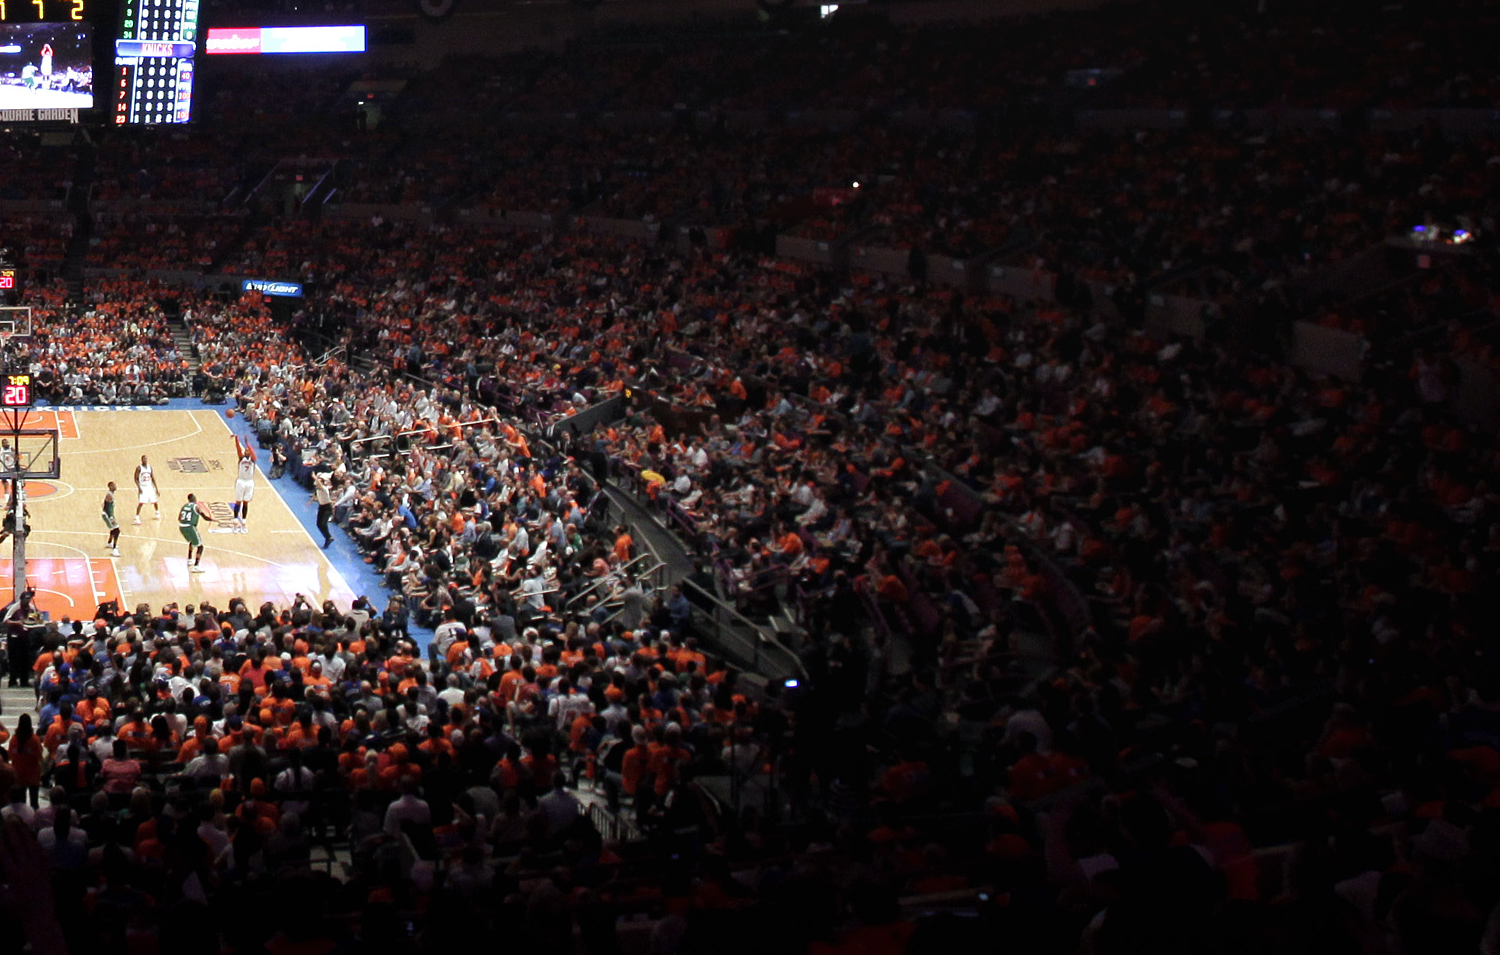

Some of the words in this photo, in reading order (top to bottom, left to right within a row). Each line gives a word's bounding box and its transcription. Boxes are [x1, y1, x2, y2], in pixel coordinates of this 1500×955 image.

[31, 0, 44, 20] 7
[71, 0, 84, 20] 2
[126, 8, 132, 16] 9
[124, 20, 134, 28] 20
[123, 31, 132, 39] 34
[141, 44, 174, 56] KNICKS
[122, 67, 127, 75] 1
[181, 72, 190, 80] 40
[120, 79, 126, 87] 6
[119, 91, 126, 99] 7
[117, 103, 126, 111] 14
[38, 108, 79, 124] GARDEN
[116, 115, 126, 123] 23
[0, 277, 13, 289] 20
[270, 285, 299, 294] LIGHT
[8, 375, 29, 386] 7:09
[4, 386, 27, 405] 20
[180, 511, 192, 521] 34
